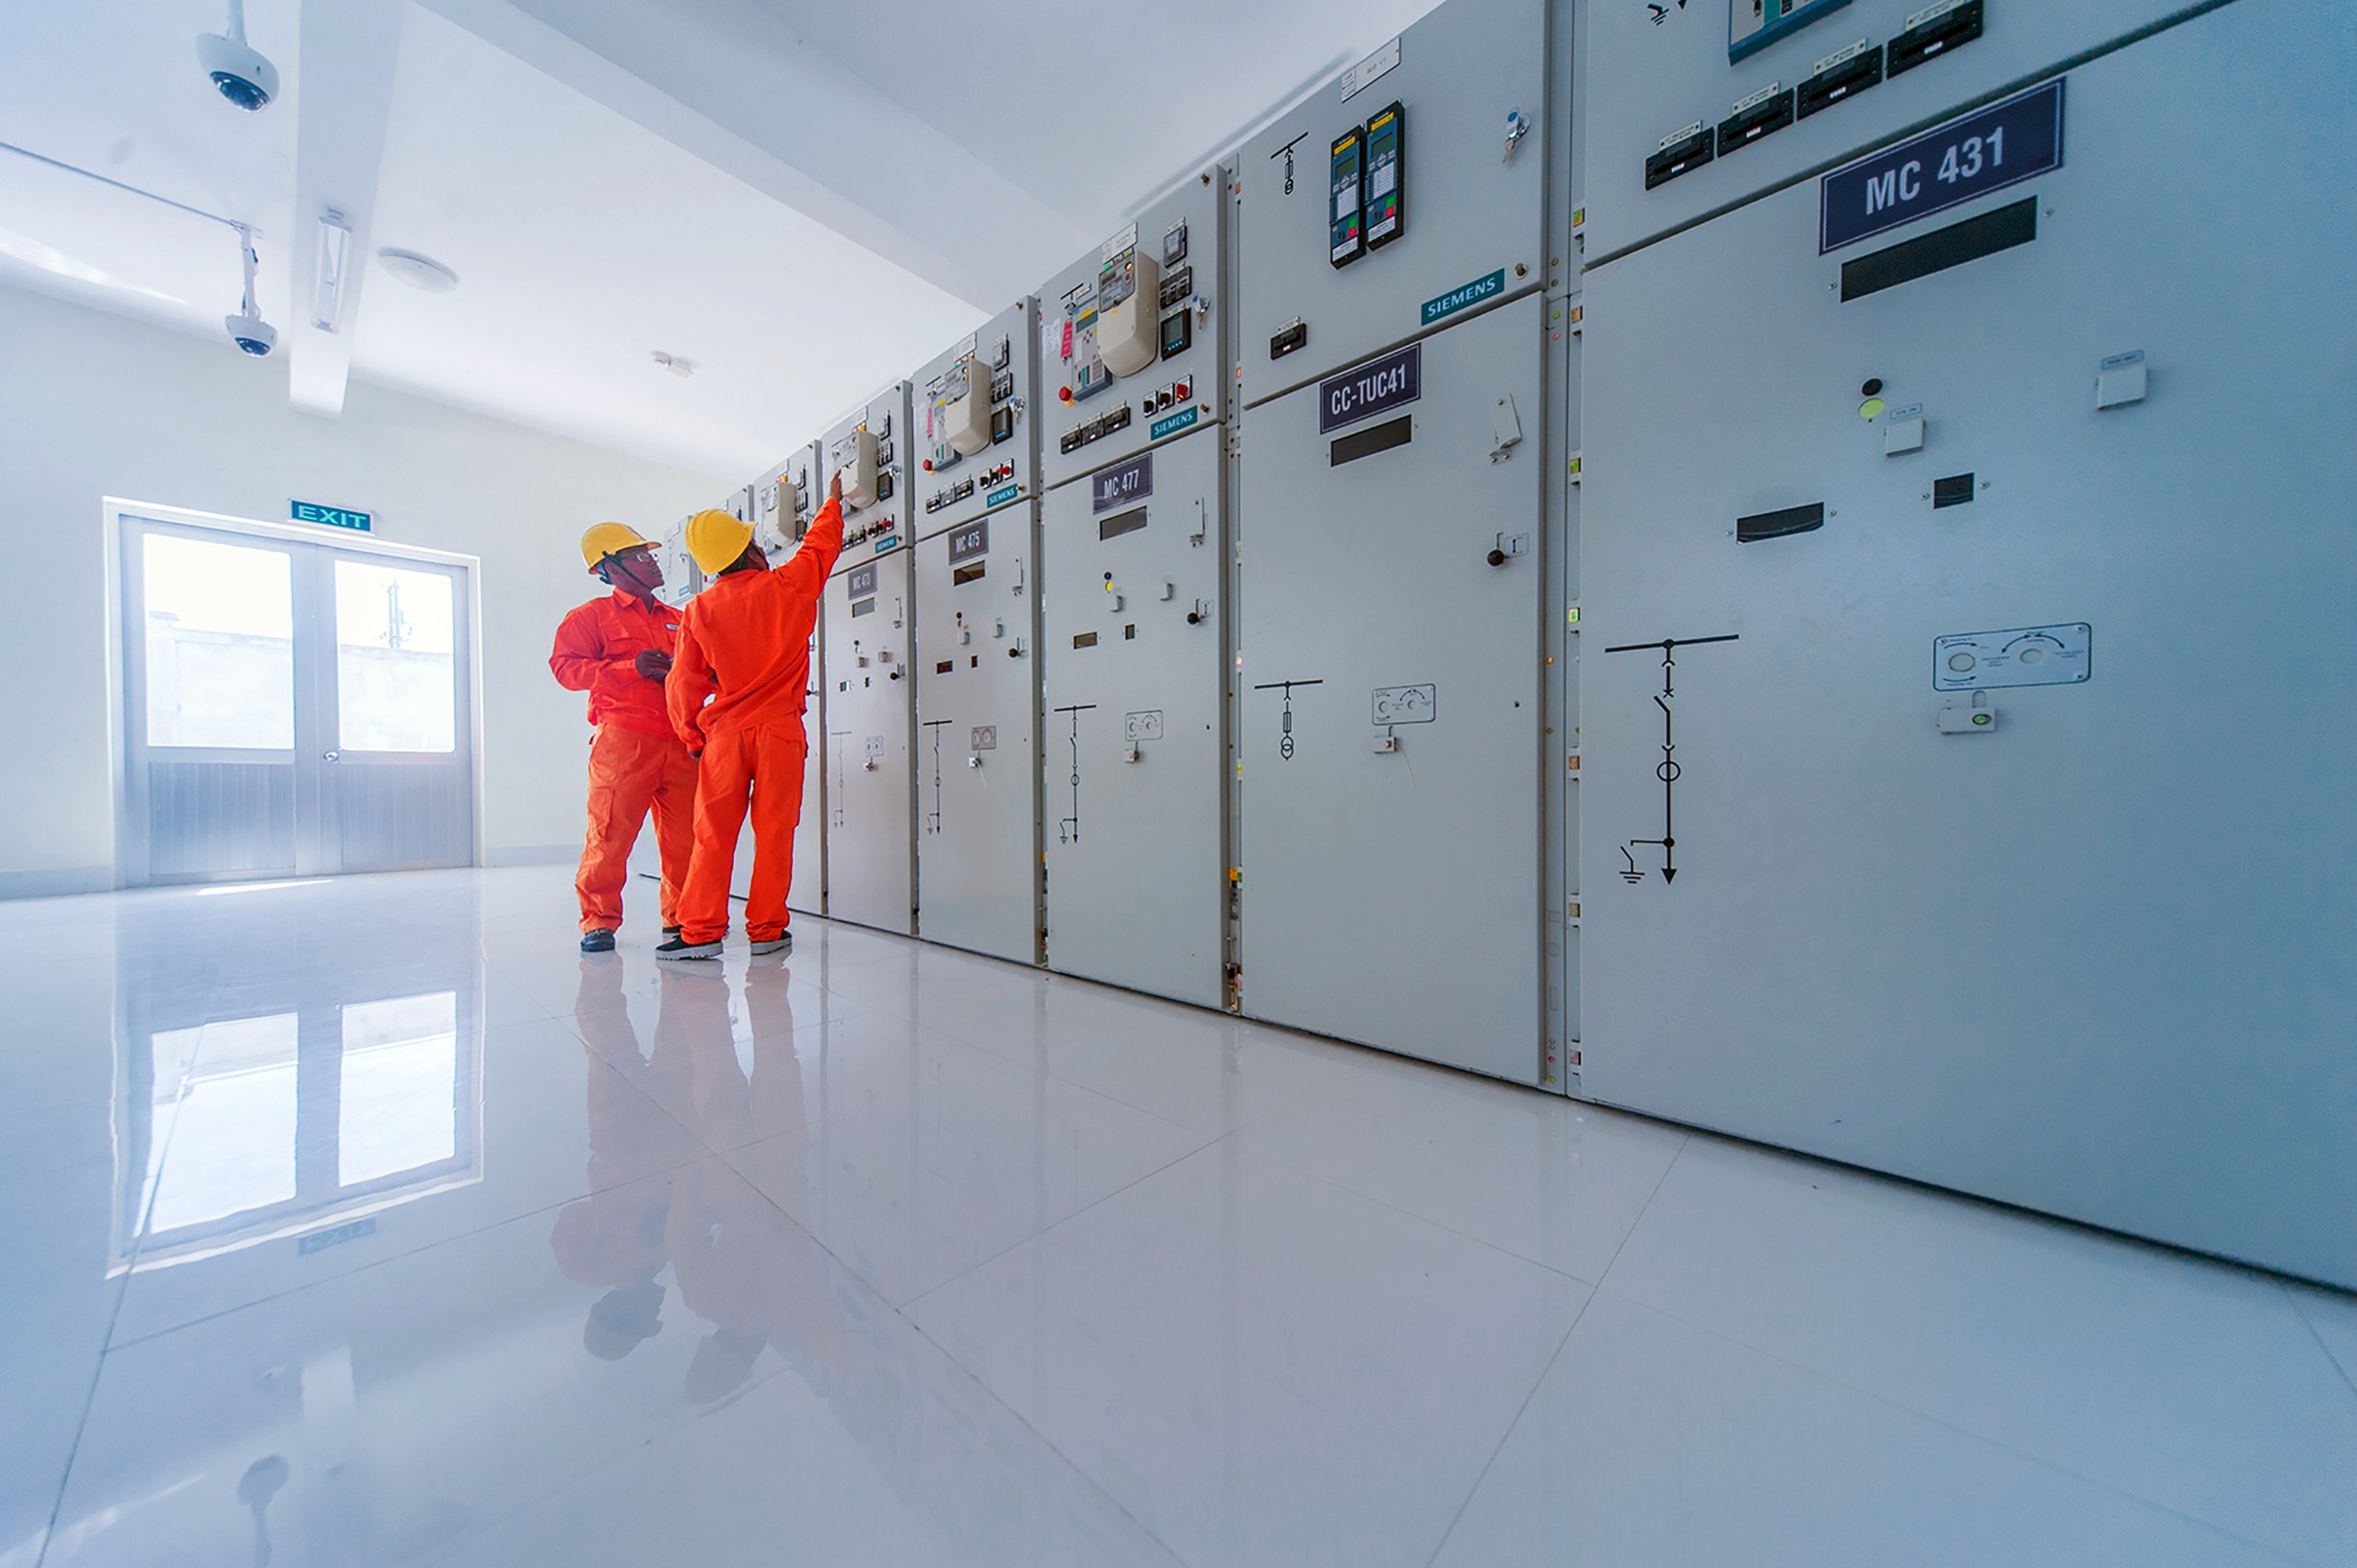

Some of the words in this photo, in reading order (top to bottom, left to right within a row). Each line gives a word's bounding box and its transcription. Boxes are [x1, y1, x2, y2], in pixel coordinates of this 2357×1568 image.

[1865, 160, 1922, 215] MC
[1937, 125, 2003, 184] 431
[1427, 277, 1496, 318] SIEMENS
[1331, 364, 1405, 415] CC-TUC41
[1154, 411, 1193, 436] SIEMENS
[1104, 476, 1119, 499] MC
[1122, 469, 1140, 492] 477
[298, 505, 366, 528] EXIT
